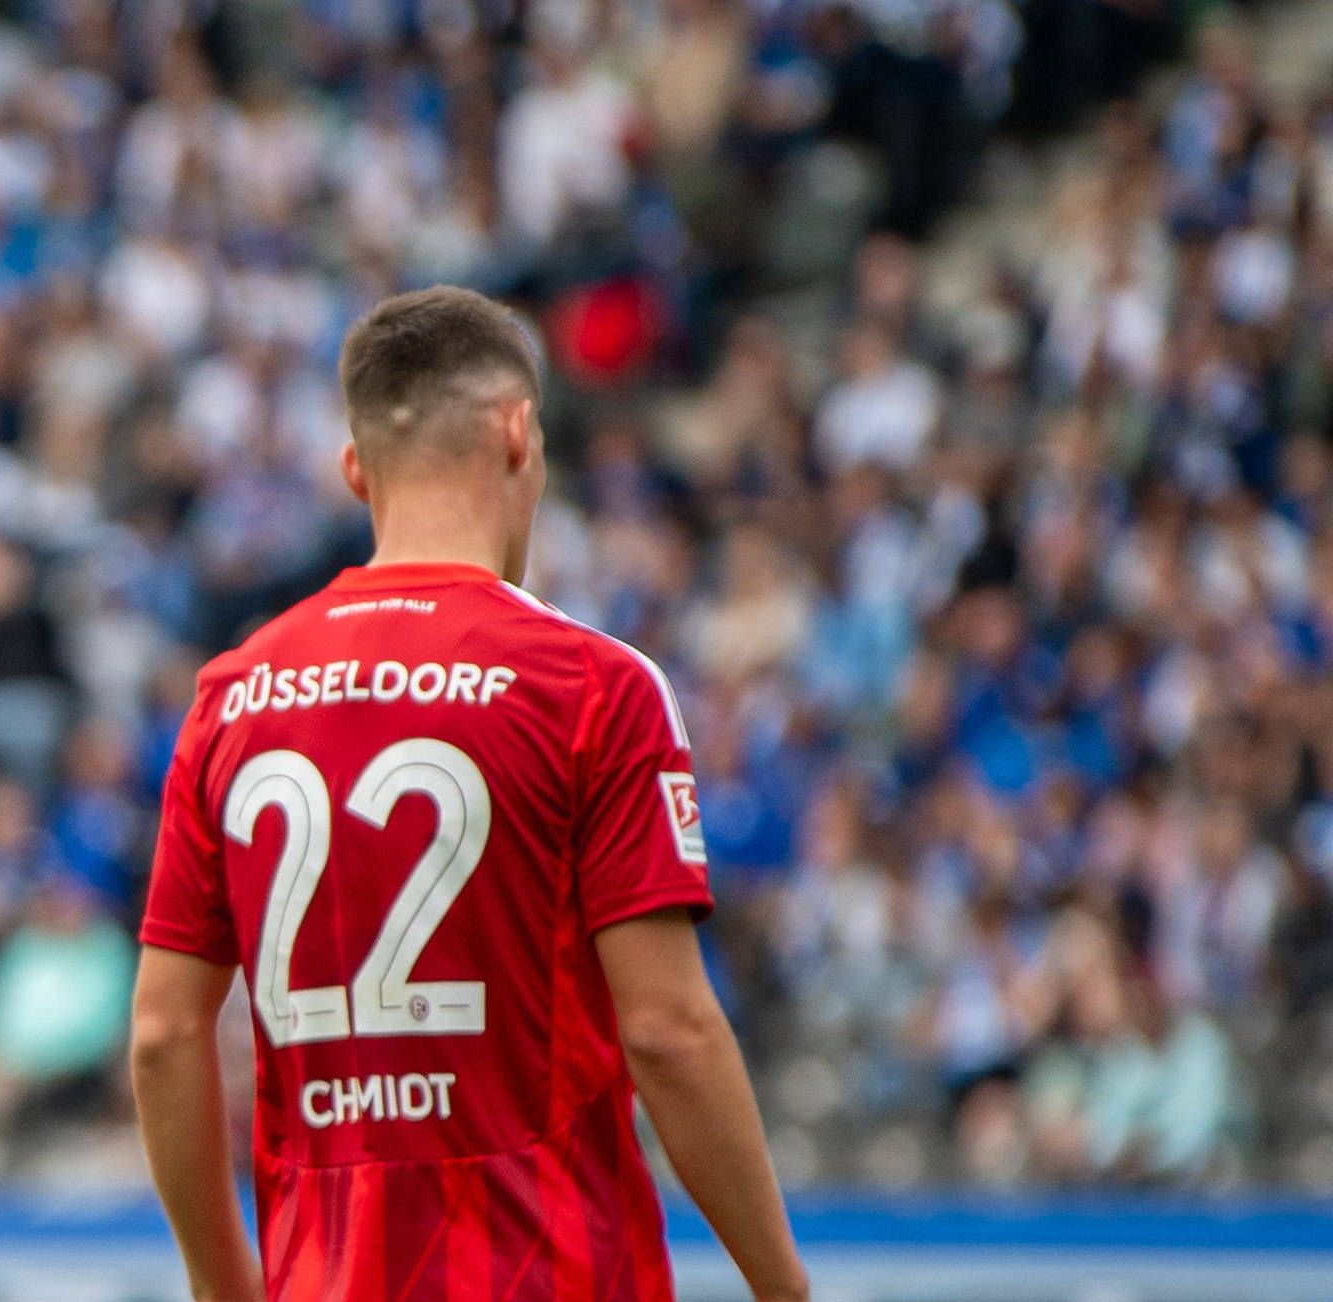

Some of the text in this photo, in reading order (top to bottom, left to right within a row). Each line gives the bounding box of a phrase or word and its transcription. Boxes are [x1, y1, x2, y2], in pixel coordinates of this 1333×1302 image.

[221, 660, 518, 724] DÜSSELDORF
[222, 737, 492, 1048] 22
[301, 1072, 456, 1129] CHMIDT
